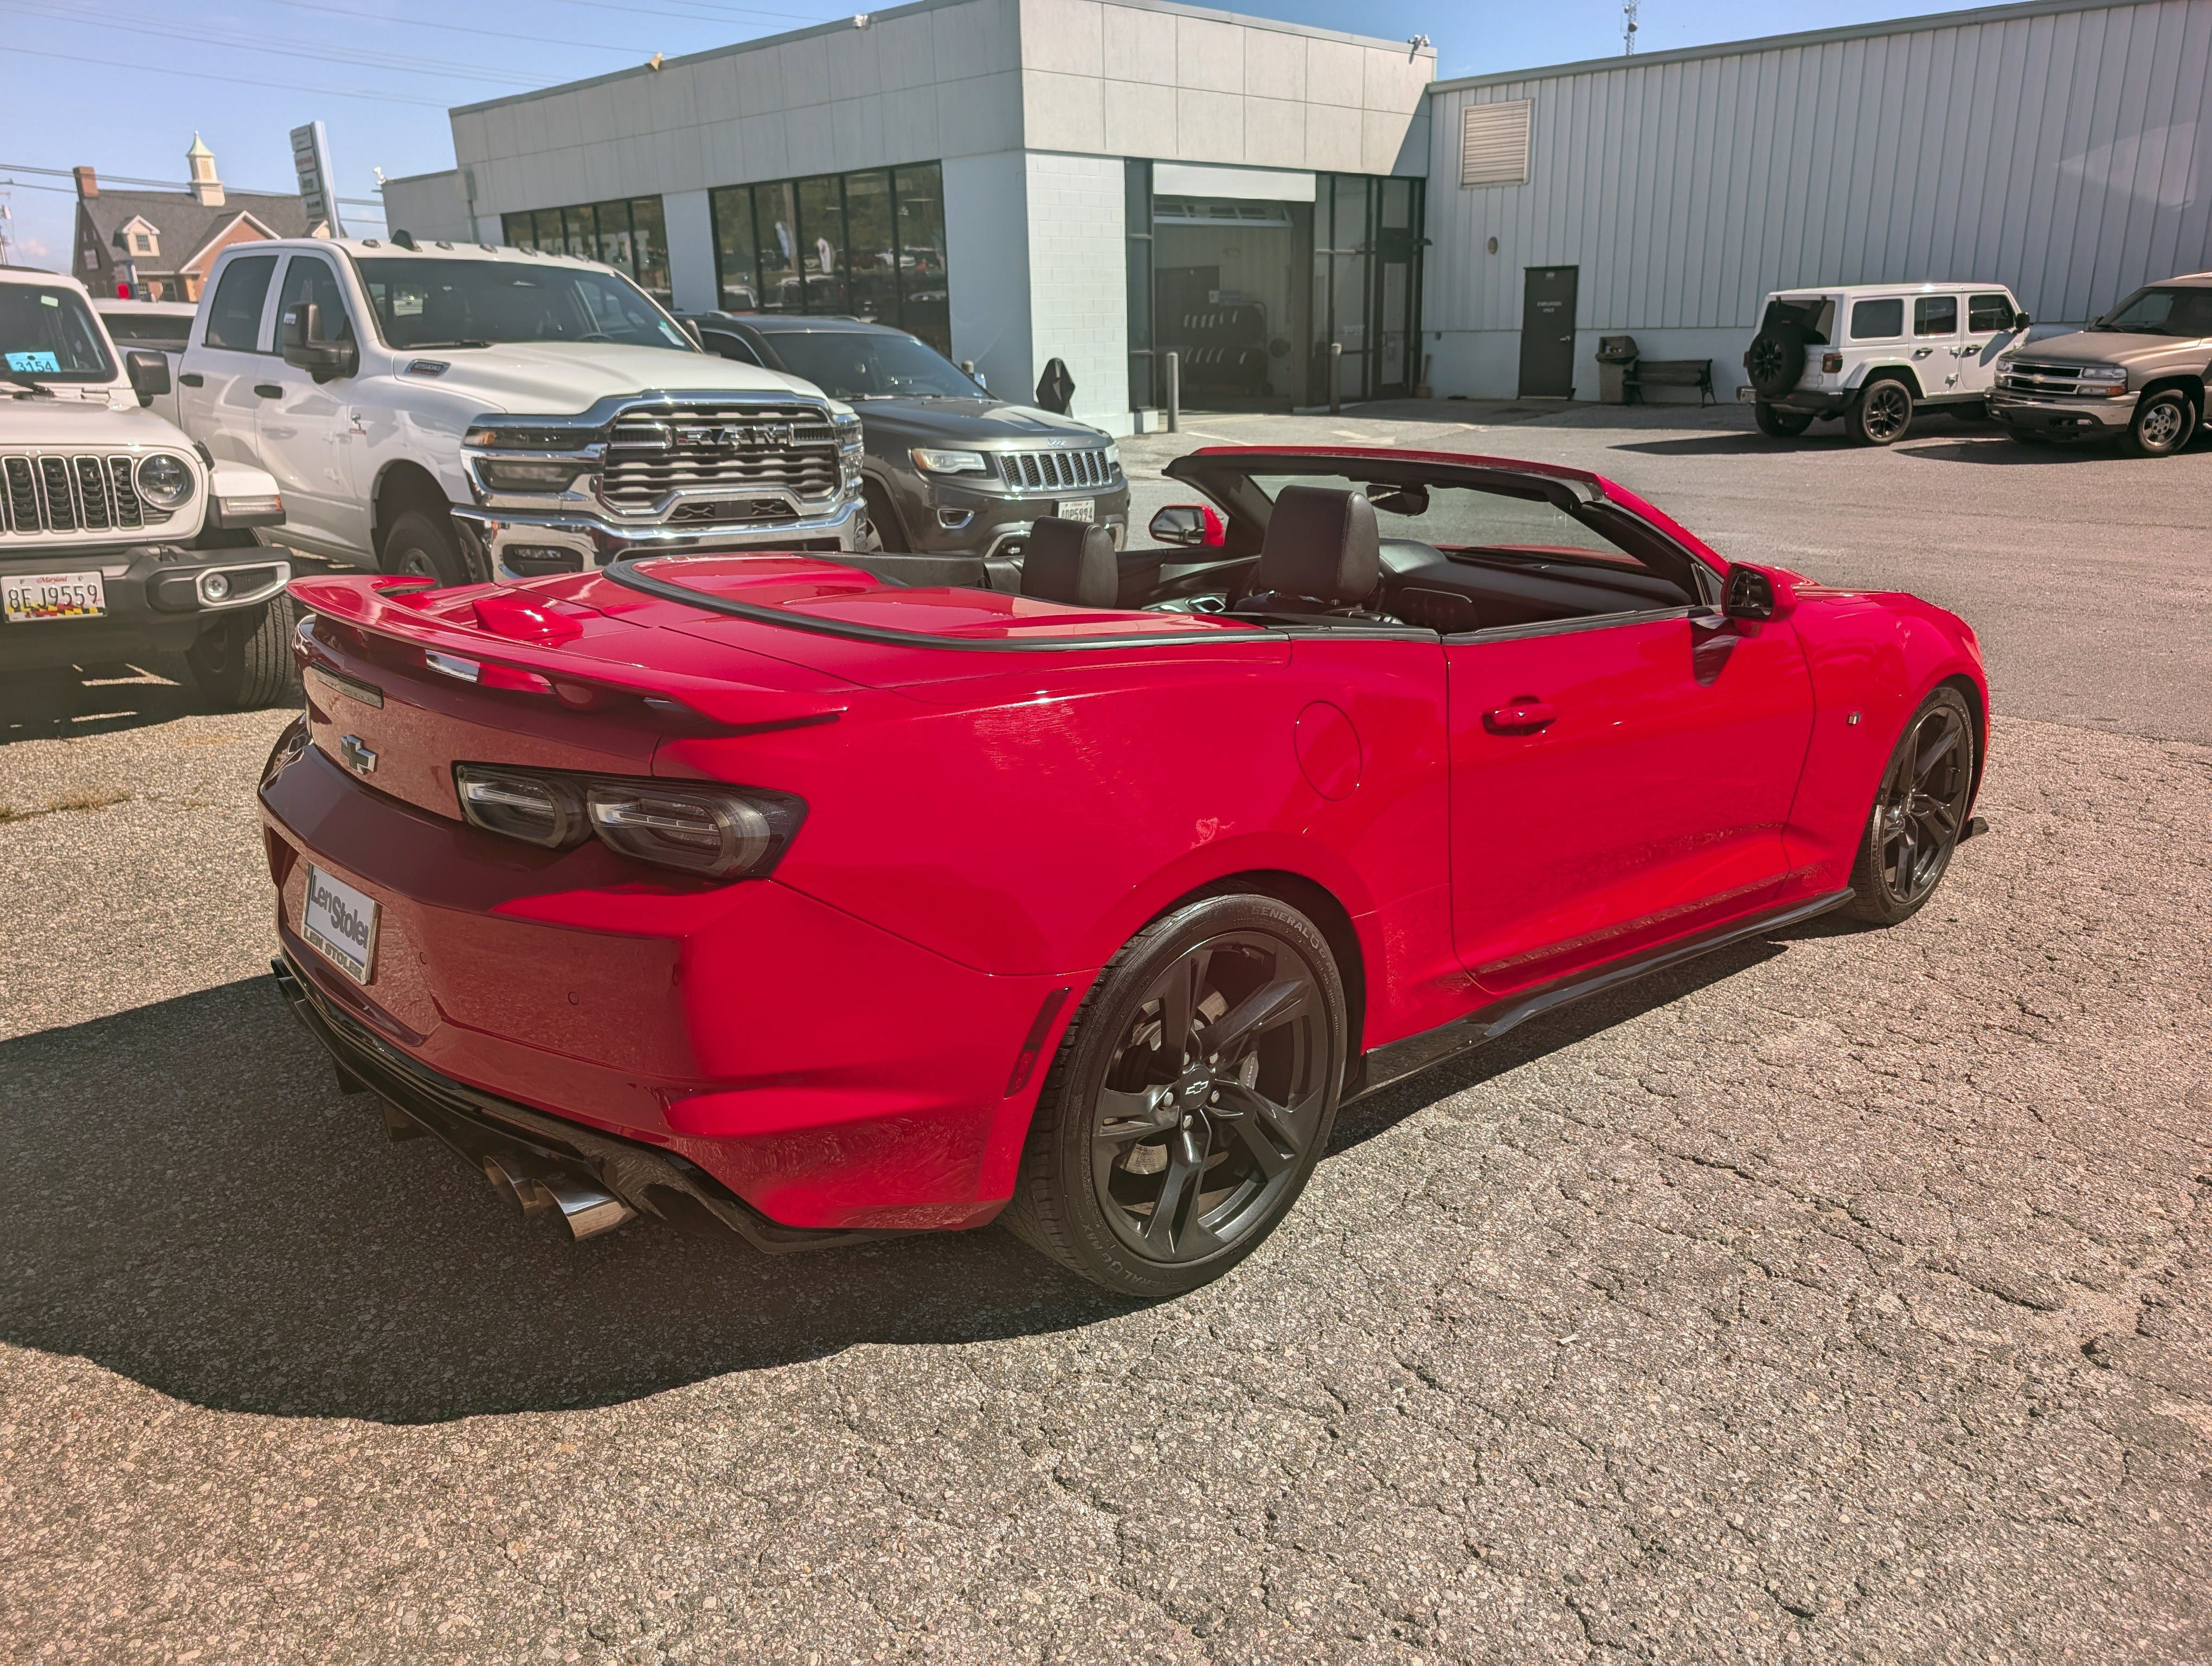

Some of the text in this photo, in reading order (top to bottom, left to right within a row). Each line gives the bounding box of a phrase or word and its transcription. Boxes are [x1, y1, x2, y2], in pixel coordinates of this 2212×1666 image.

[16, 361, 54, 373] 3154
[676, 425, 787, 445] RAM
[36, 575, 67, 584] Maryland
[8, 582, 99, 609] 8EJ9559
[1250, 905, 1309, 938] GENERAL
[304, 926, 363, 982] LEN STOLER
